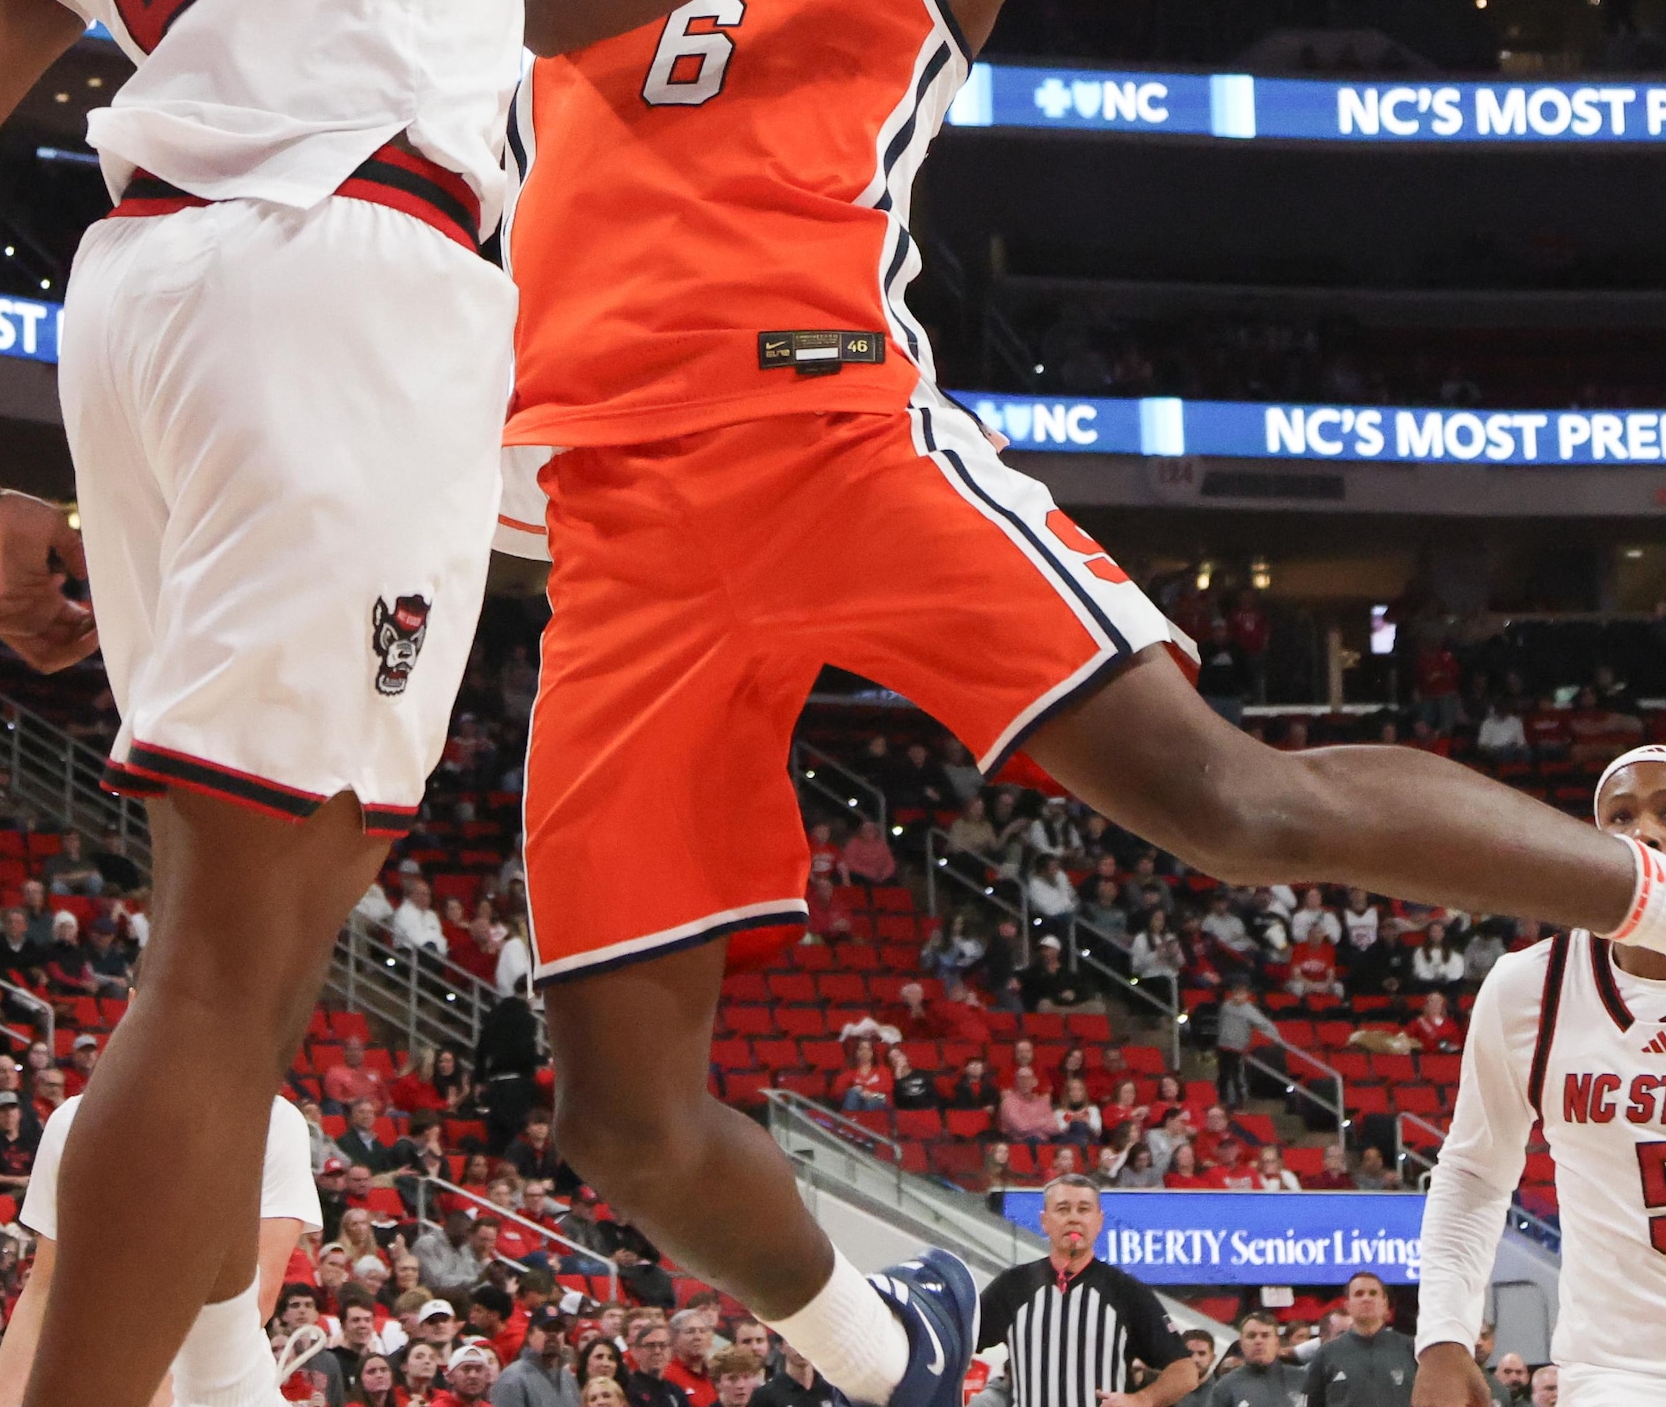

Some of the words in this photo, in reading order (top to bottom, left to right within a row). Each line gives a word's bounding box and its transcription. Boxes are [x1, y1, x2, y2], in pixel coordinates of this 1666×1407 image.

[1102, 82, 1169, 123] NC
[1475, 88, 1636, 135] MOST
[847, 339, 869, 353] 46
[1032, 405, 1099, 446] NC
[1396, 411, 1547, 460] MOST
[1563, 1073, 1623, 1125] NC
[1101, 1229, 1227, 1265] IBERTY
[1230, 1228, 1330, 1265] Senior
[1334, 1228, 1421, 1280] Living
